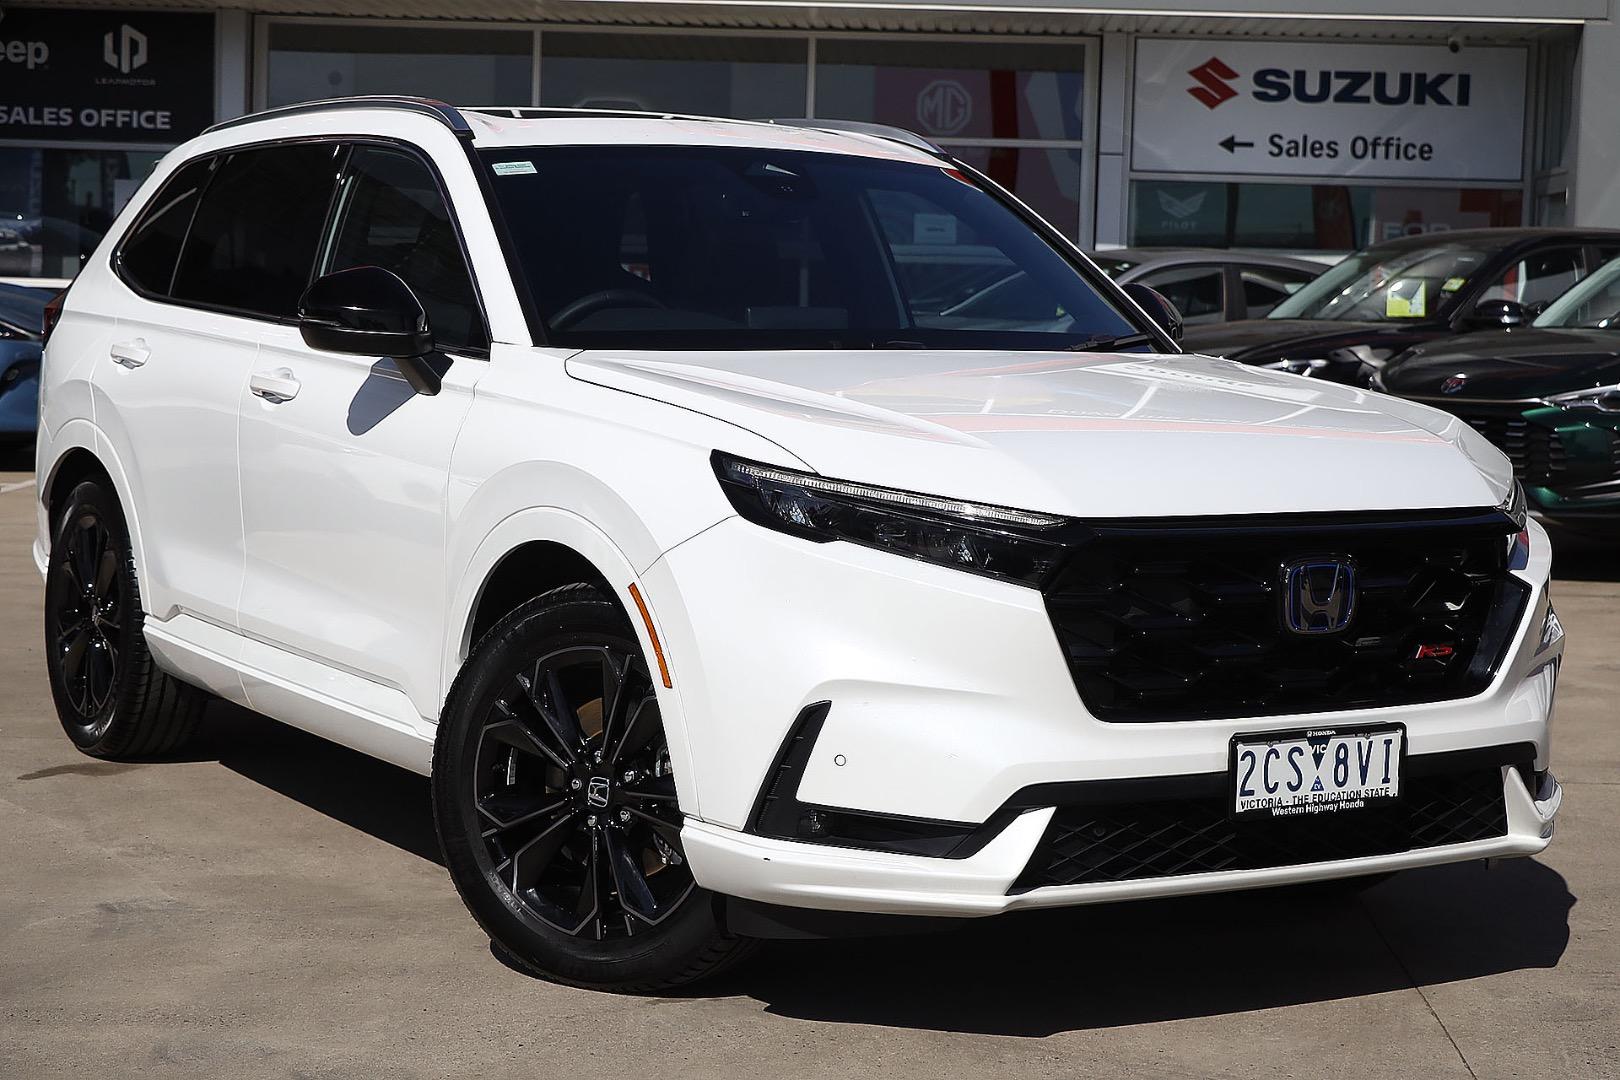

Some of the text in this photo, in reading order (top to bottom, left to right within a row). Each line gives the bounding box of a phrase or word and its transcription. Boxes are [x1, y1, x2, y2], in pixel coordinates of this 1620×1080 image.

[1252, 68, 1470, 107] SUZUKI
[0, 105, 172, 130] SALES OFFICE
[922, 86, 966, 129] MG
[1267, 133, 1434, 162] Sales Office
[1309, 743, 1327, 754] VIC
[1240, 797, 1283, 810] VICTORIA
[1292, 794, 1309, 806] THE
[1312, 789, 1362, 803] EDUCATION
[1364, 787, 1390, 798] STATE
[1272, 799, 1364, 816] Western Highway Honda
